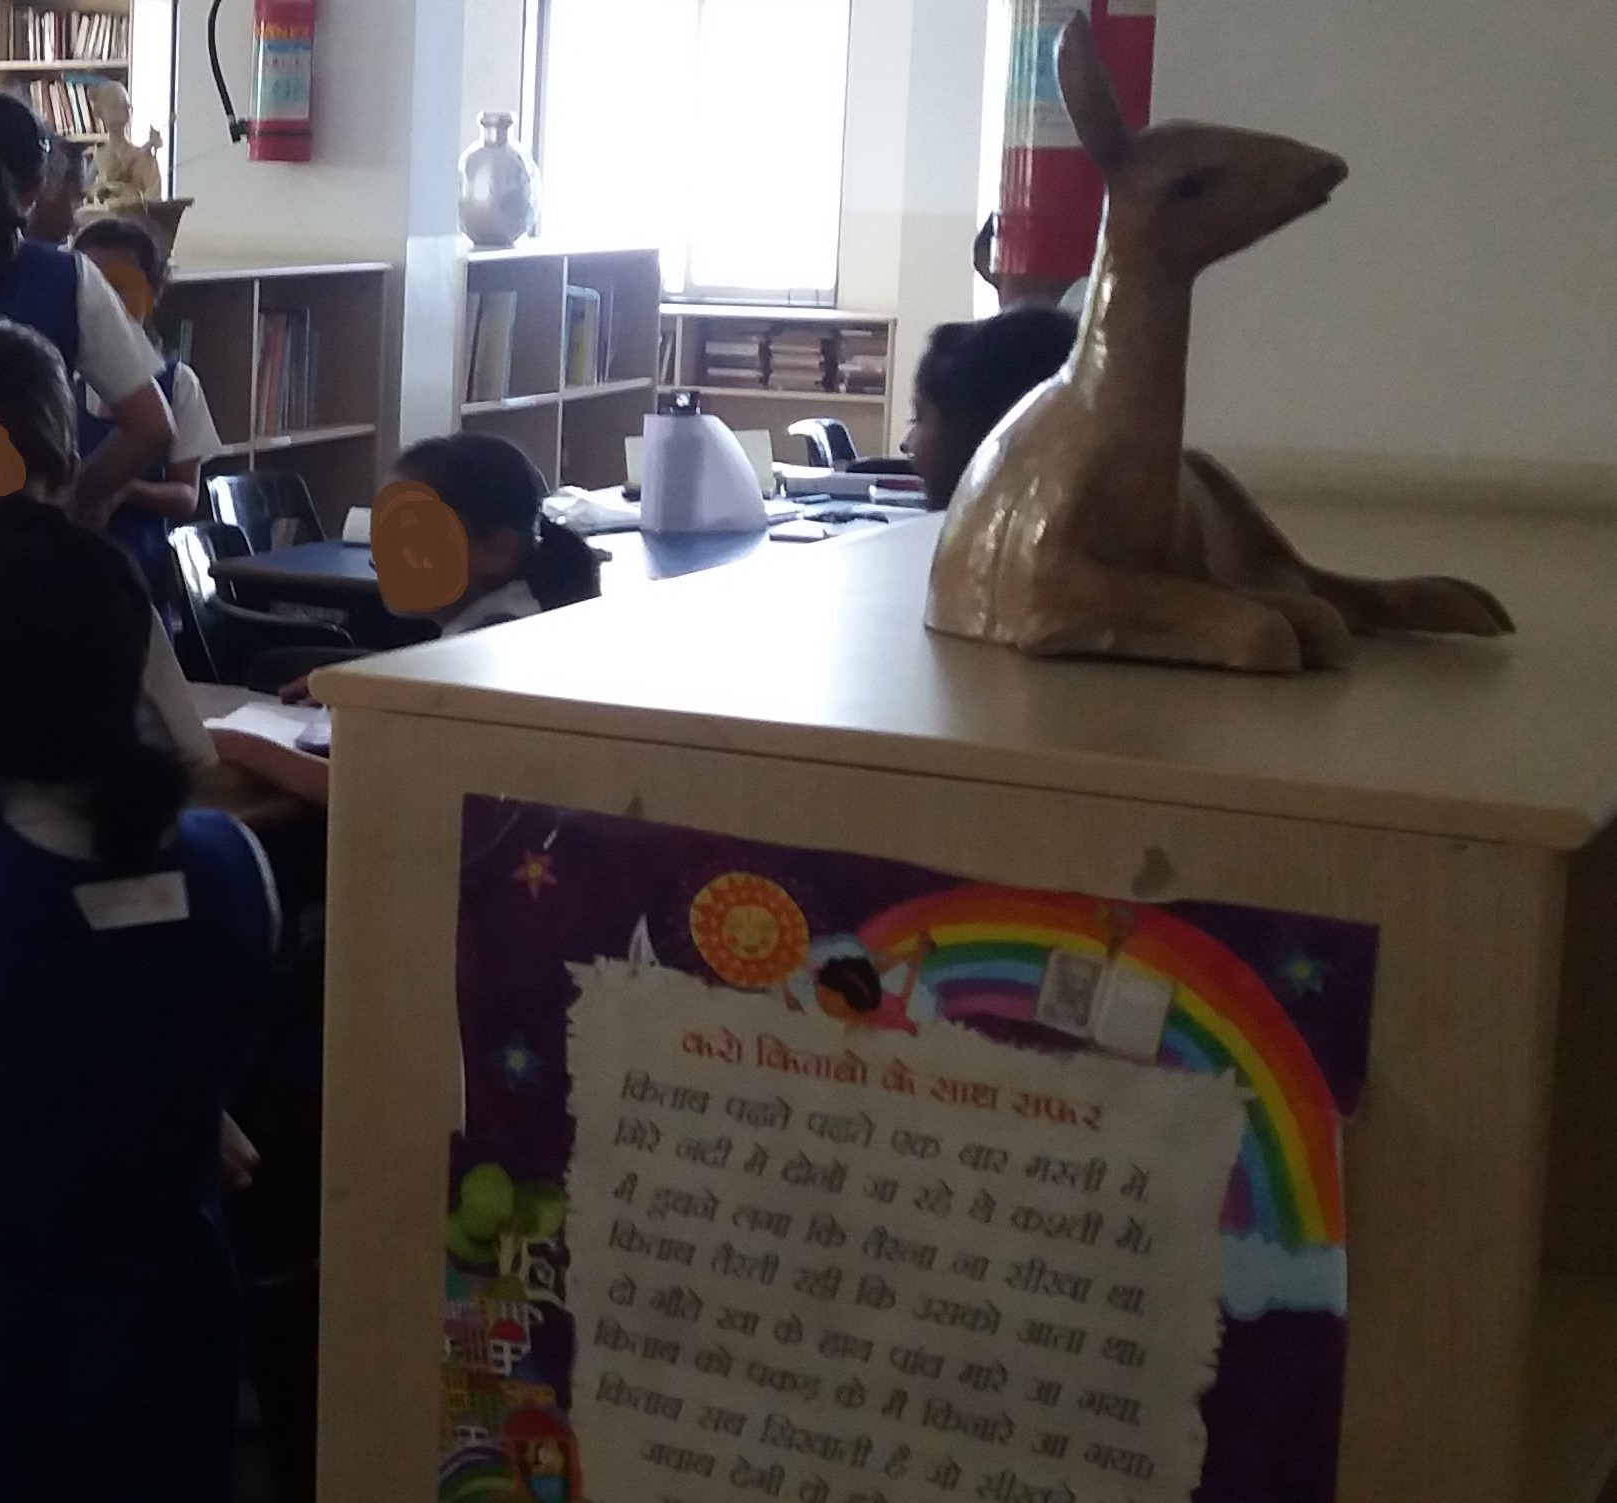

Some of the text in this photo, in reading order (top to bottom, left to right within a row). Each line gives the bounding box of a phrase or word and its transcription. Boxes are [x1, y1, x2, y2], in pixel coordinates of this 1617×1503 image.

[681, 1027, 743, 1064] करो
[929, 1076, 999, 1110] साथ
[620, 1071, 711, 1115] किताब
[1024, 1155, 1108, 1193] मस्ती
[675, 1136, 734, 1169] नदी
[868, 1178, 900, 1204] जा
[607, 1219, 697, 1267] किताब
[854, 1275, 897, 1311] कि
[805, 1214, 848, 1249] कि
[593, 1314, 683, 1366] किताब
[834, 1376, 868, 1410] के
[772, 1313, 804, 1345] के
[595, 1372, 684, 1422] किताब
